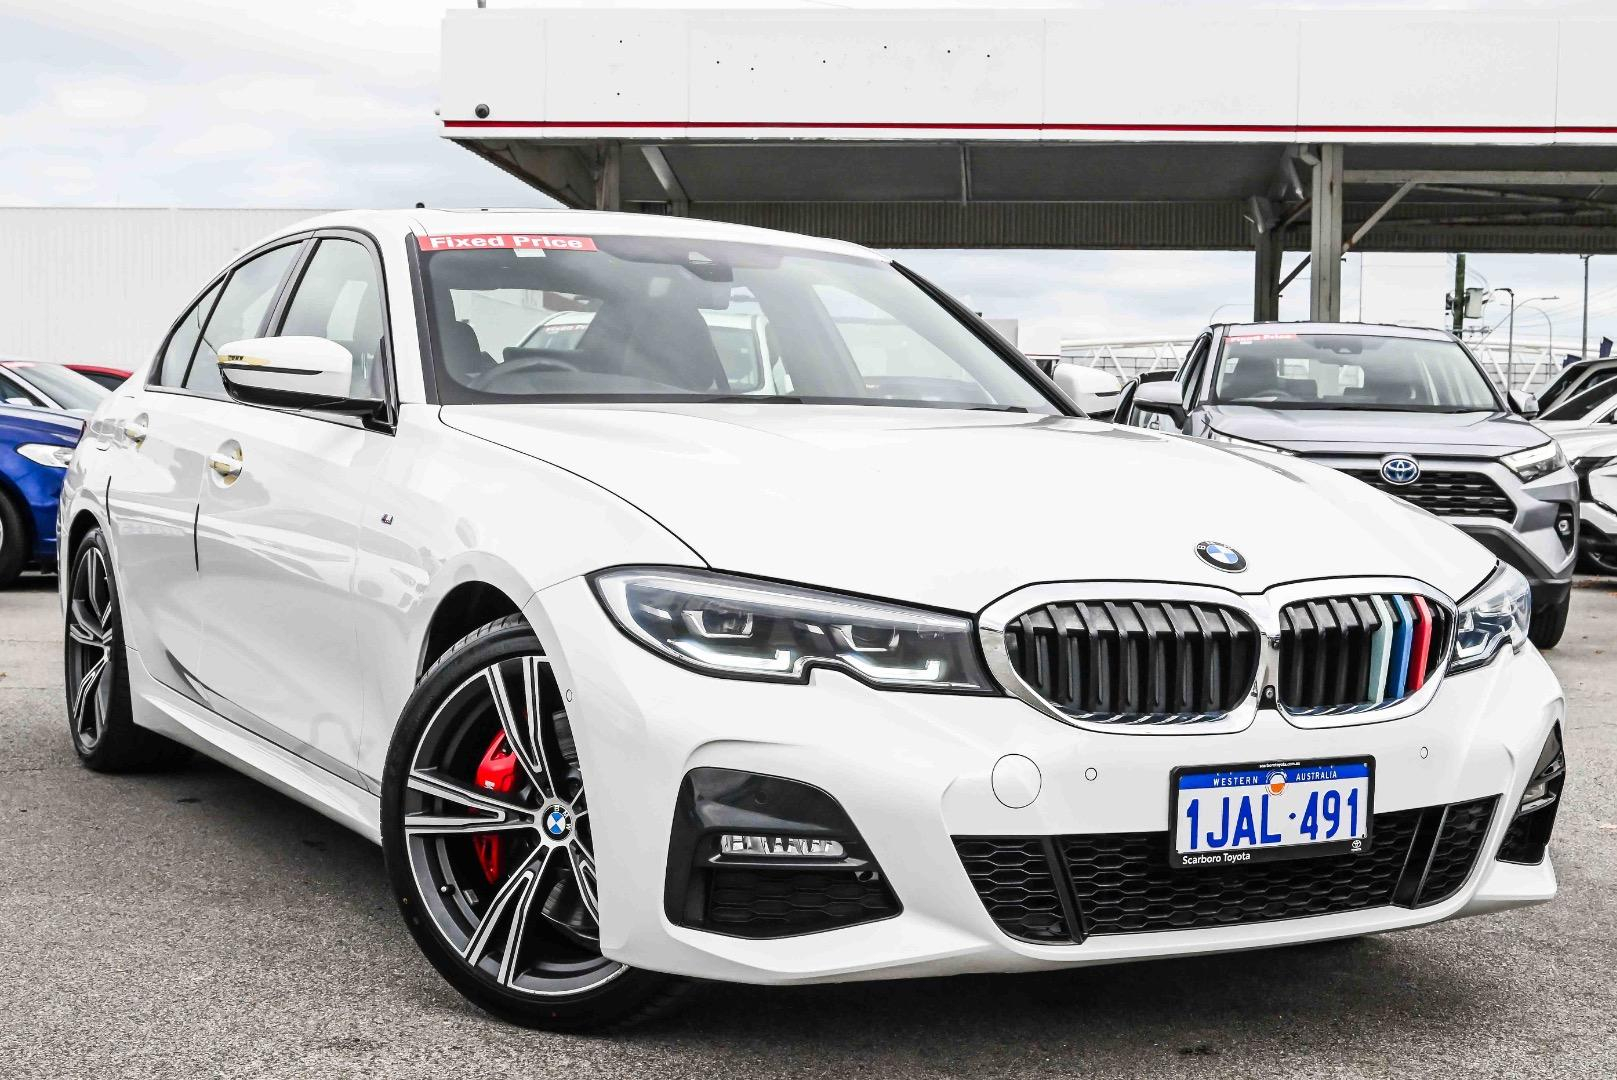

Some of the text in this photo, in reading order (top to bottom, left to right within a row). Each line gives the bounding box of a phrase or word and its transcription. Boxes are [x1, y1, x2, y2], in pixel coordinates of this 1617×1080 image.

[429, 236, 583, 249] Fixed Price
[1213, 770, 1338, 787] WESTERN AUSTRALIA
[1182, 851, 1251, 865] Scarboro Toyota
